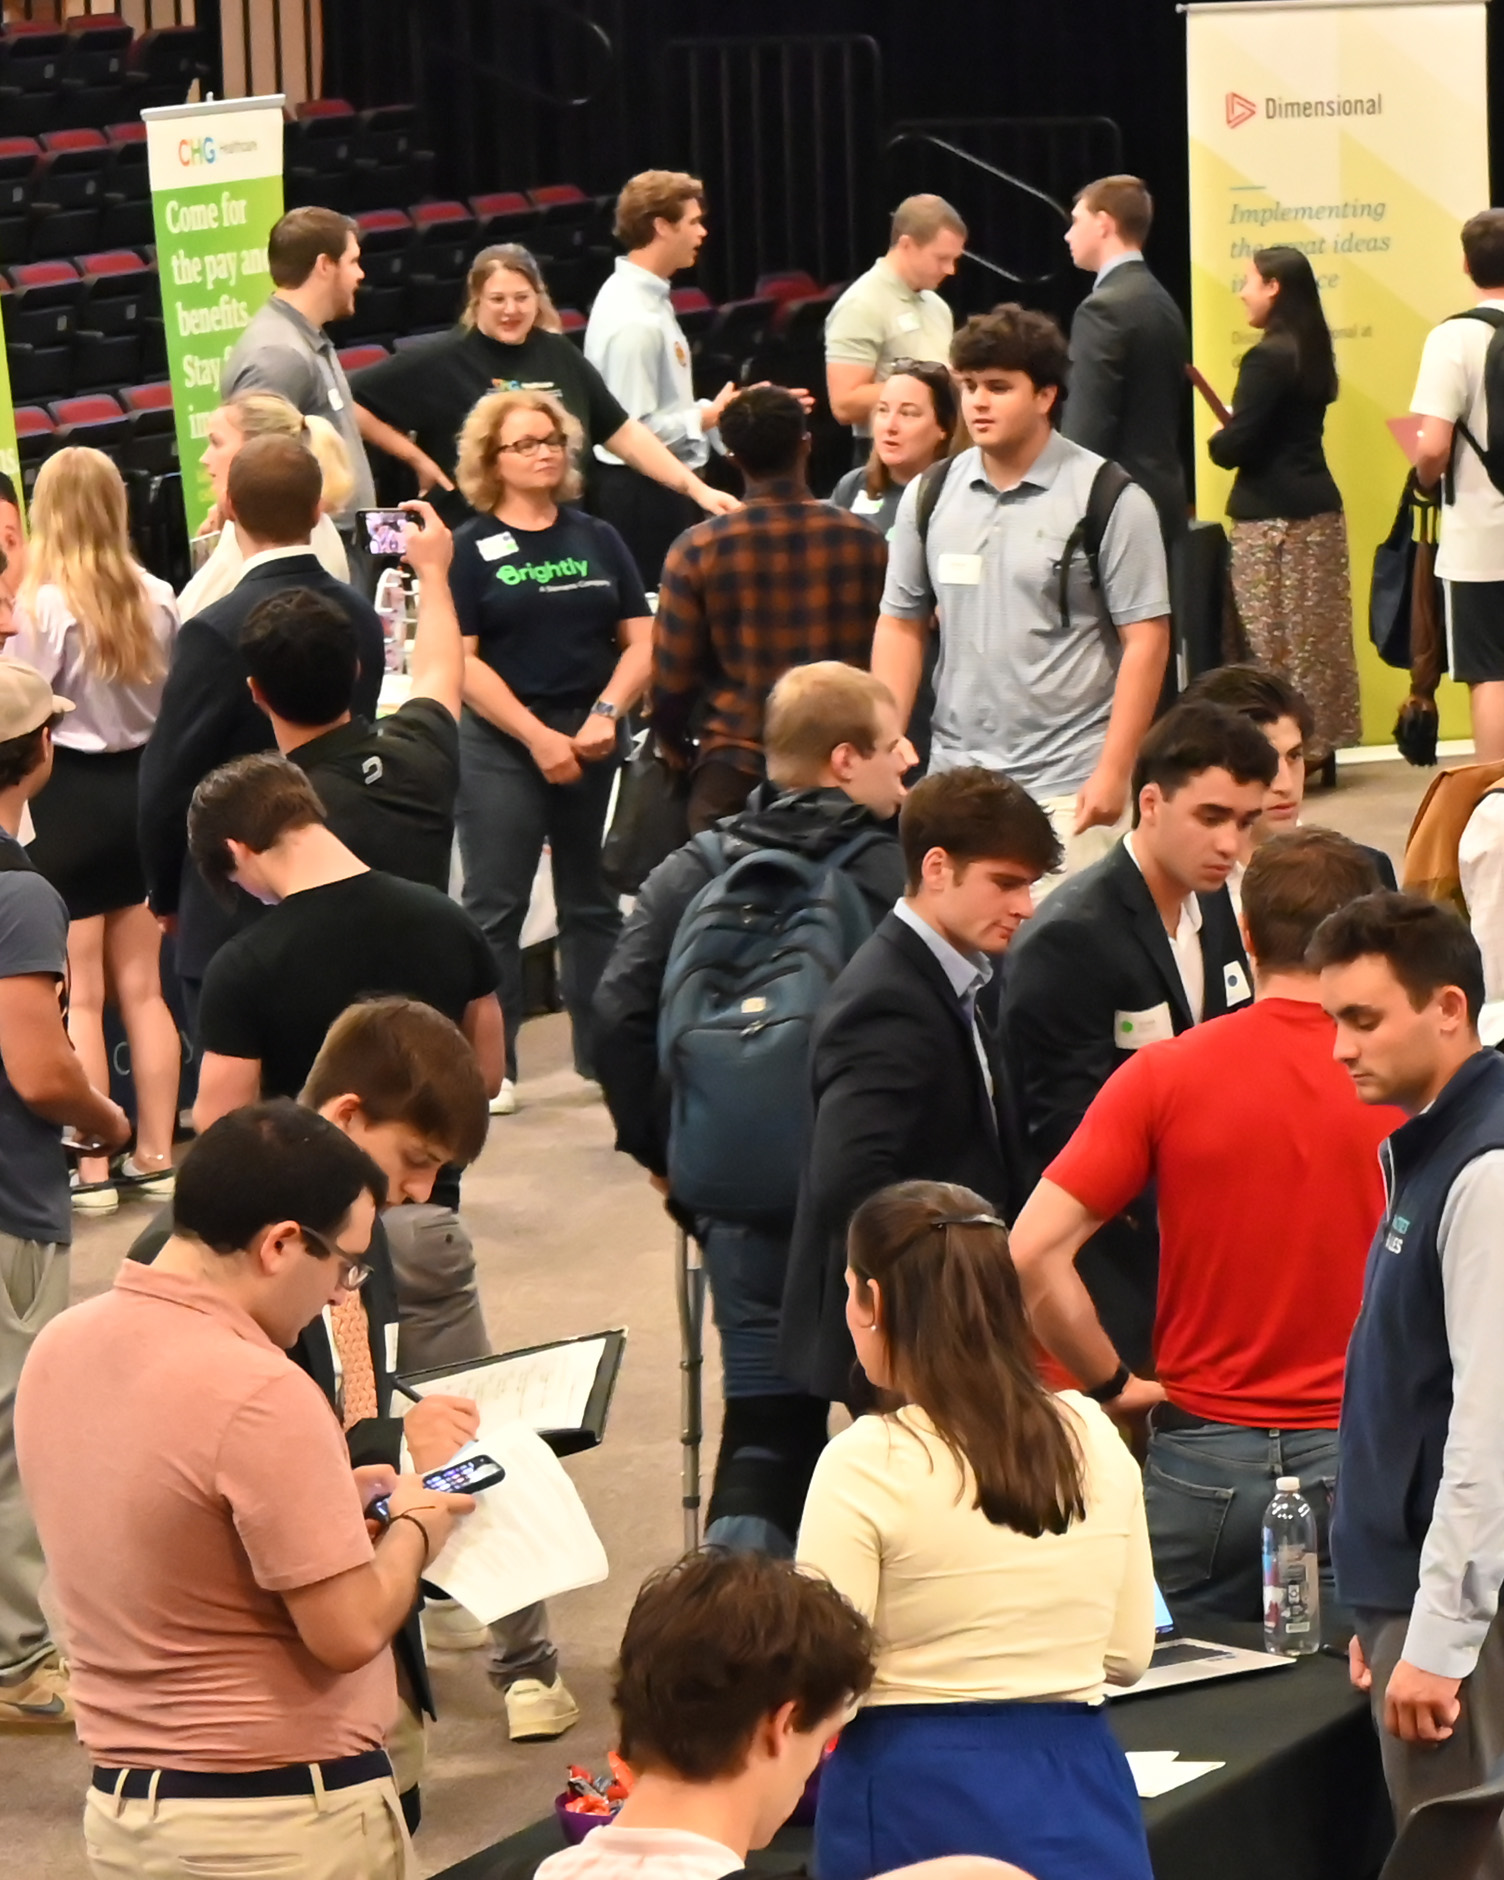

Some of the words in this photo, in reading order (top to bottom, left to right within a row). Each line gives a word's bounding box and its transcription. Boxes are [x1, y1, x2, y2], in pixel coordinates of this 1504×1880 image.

[1265, 93, 1382, 119] Dimensional
[178, 137, 216, 167] CHG
[165, 200, 219, 234] Come
[221, 191, 247, 227] for
[1229, 198, 1387, 227] Implementing
[1333, 232, 1391, 253] ideas
[171, 249, 202, 286] the
[203, 252, 237, 290] pay
[183, 354, 220, 392] Stay
[496, 557, 588, 585] Brightly
